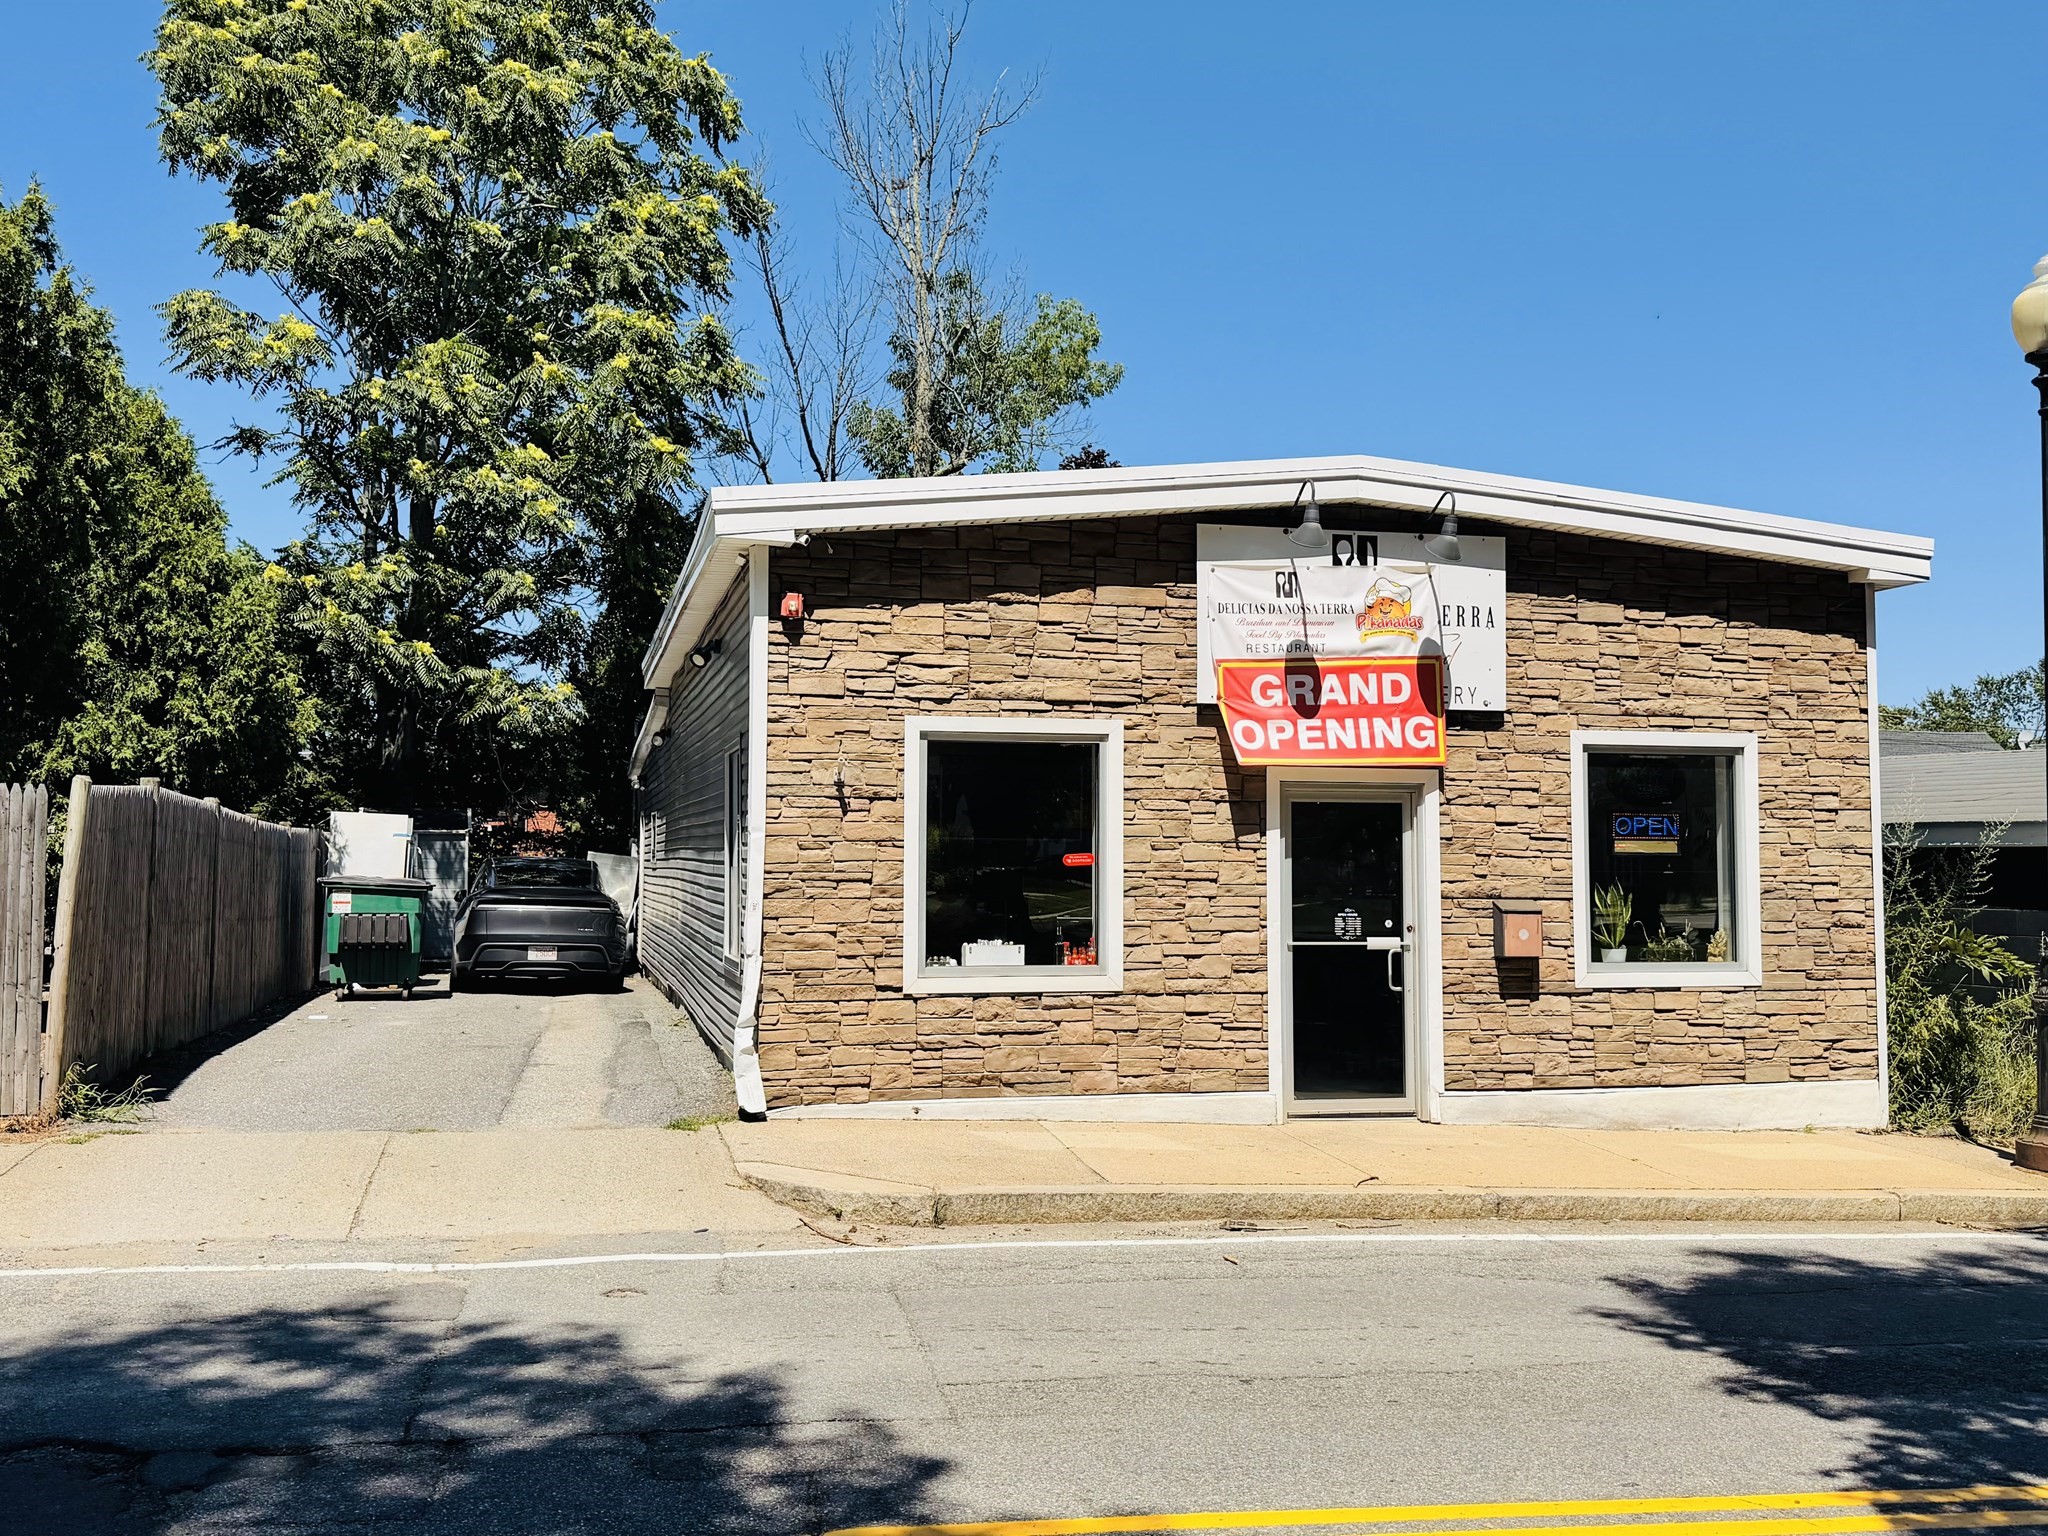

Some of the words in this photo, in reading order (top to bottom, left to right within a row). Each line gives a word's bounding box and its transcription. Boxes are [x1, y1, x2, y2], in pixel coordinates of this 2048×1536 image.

[1217, 603, 1266, 614] DELICIAS
[1268, 603, 1283, 615] DA
[1285, 603, 1318, 615] NOSSA
[1320, 603, 1355, 615] TERRA
[1442, 604, 1495, 628] ERRA
[1246, 643, 1326, 653] RESTAURANT
[1251, 673, 1411, 707] GRAND
[1443, 686, 1477, 704] ERY
[1232, 715, 1436, 750] OPENING
[1615, 817, 1677, 835] OPEN
